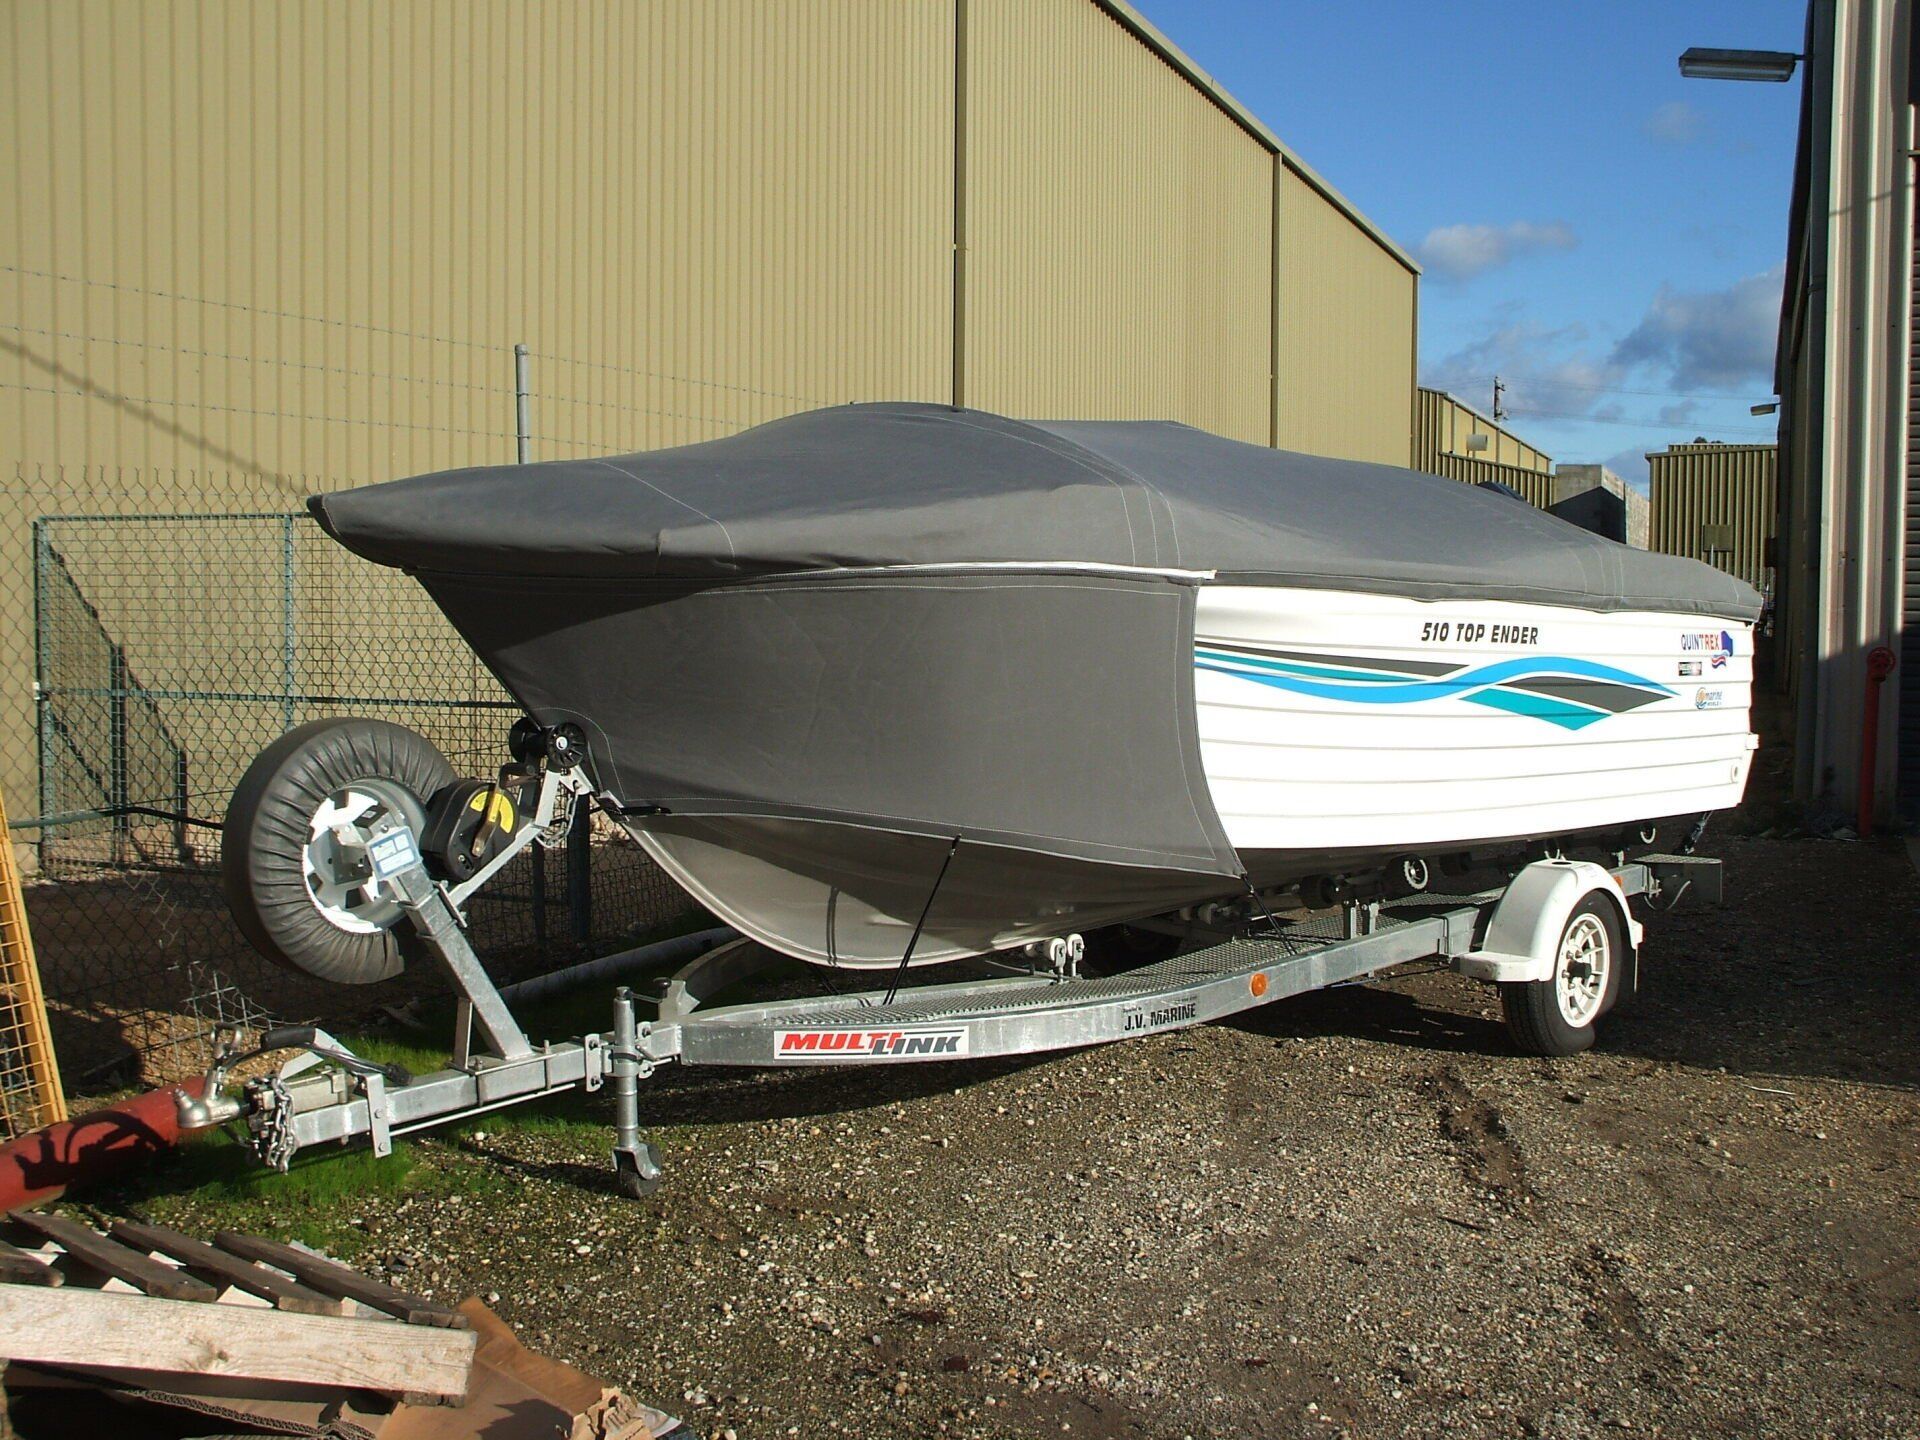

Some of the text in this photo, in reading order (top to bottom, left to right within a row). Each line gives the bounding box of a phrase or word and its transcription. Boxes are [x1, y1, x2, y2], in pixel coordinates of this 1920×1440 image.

[1421, 622, 1539, 645] 510 TOP ENDER
[1681, 633, 1720, 651] QUINTREX
[1124, 1003, 1196, 1031] J.V. MARINE
